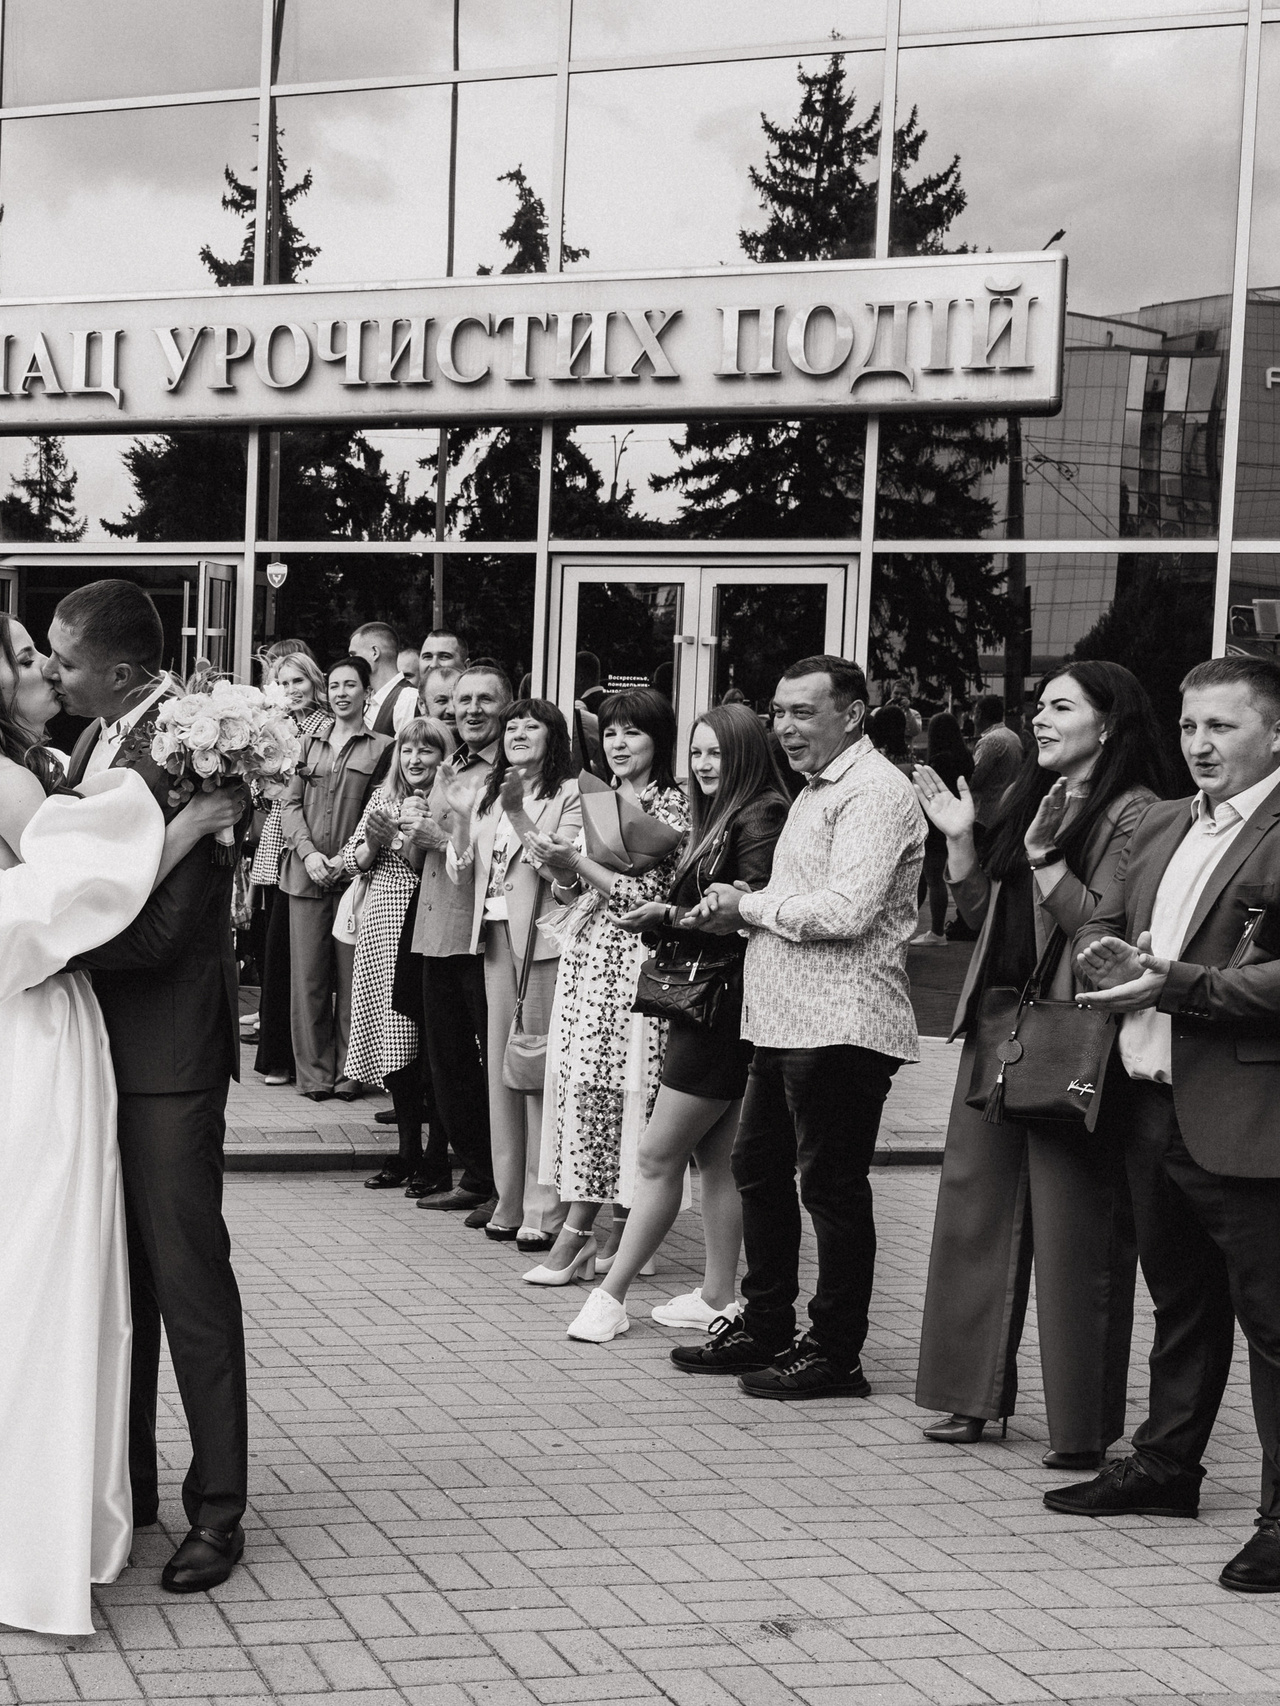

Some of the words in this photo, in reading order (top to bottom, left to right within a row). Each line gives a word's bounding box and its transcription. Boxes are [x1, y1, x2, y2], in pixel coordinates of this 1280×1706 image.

[153, 309, 683, 393] УРОЧИСТИХ
[714, 276, 1038, 393] ПОДІЙ
[608, 674, 650, 682] Воскресенье,
